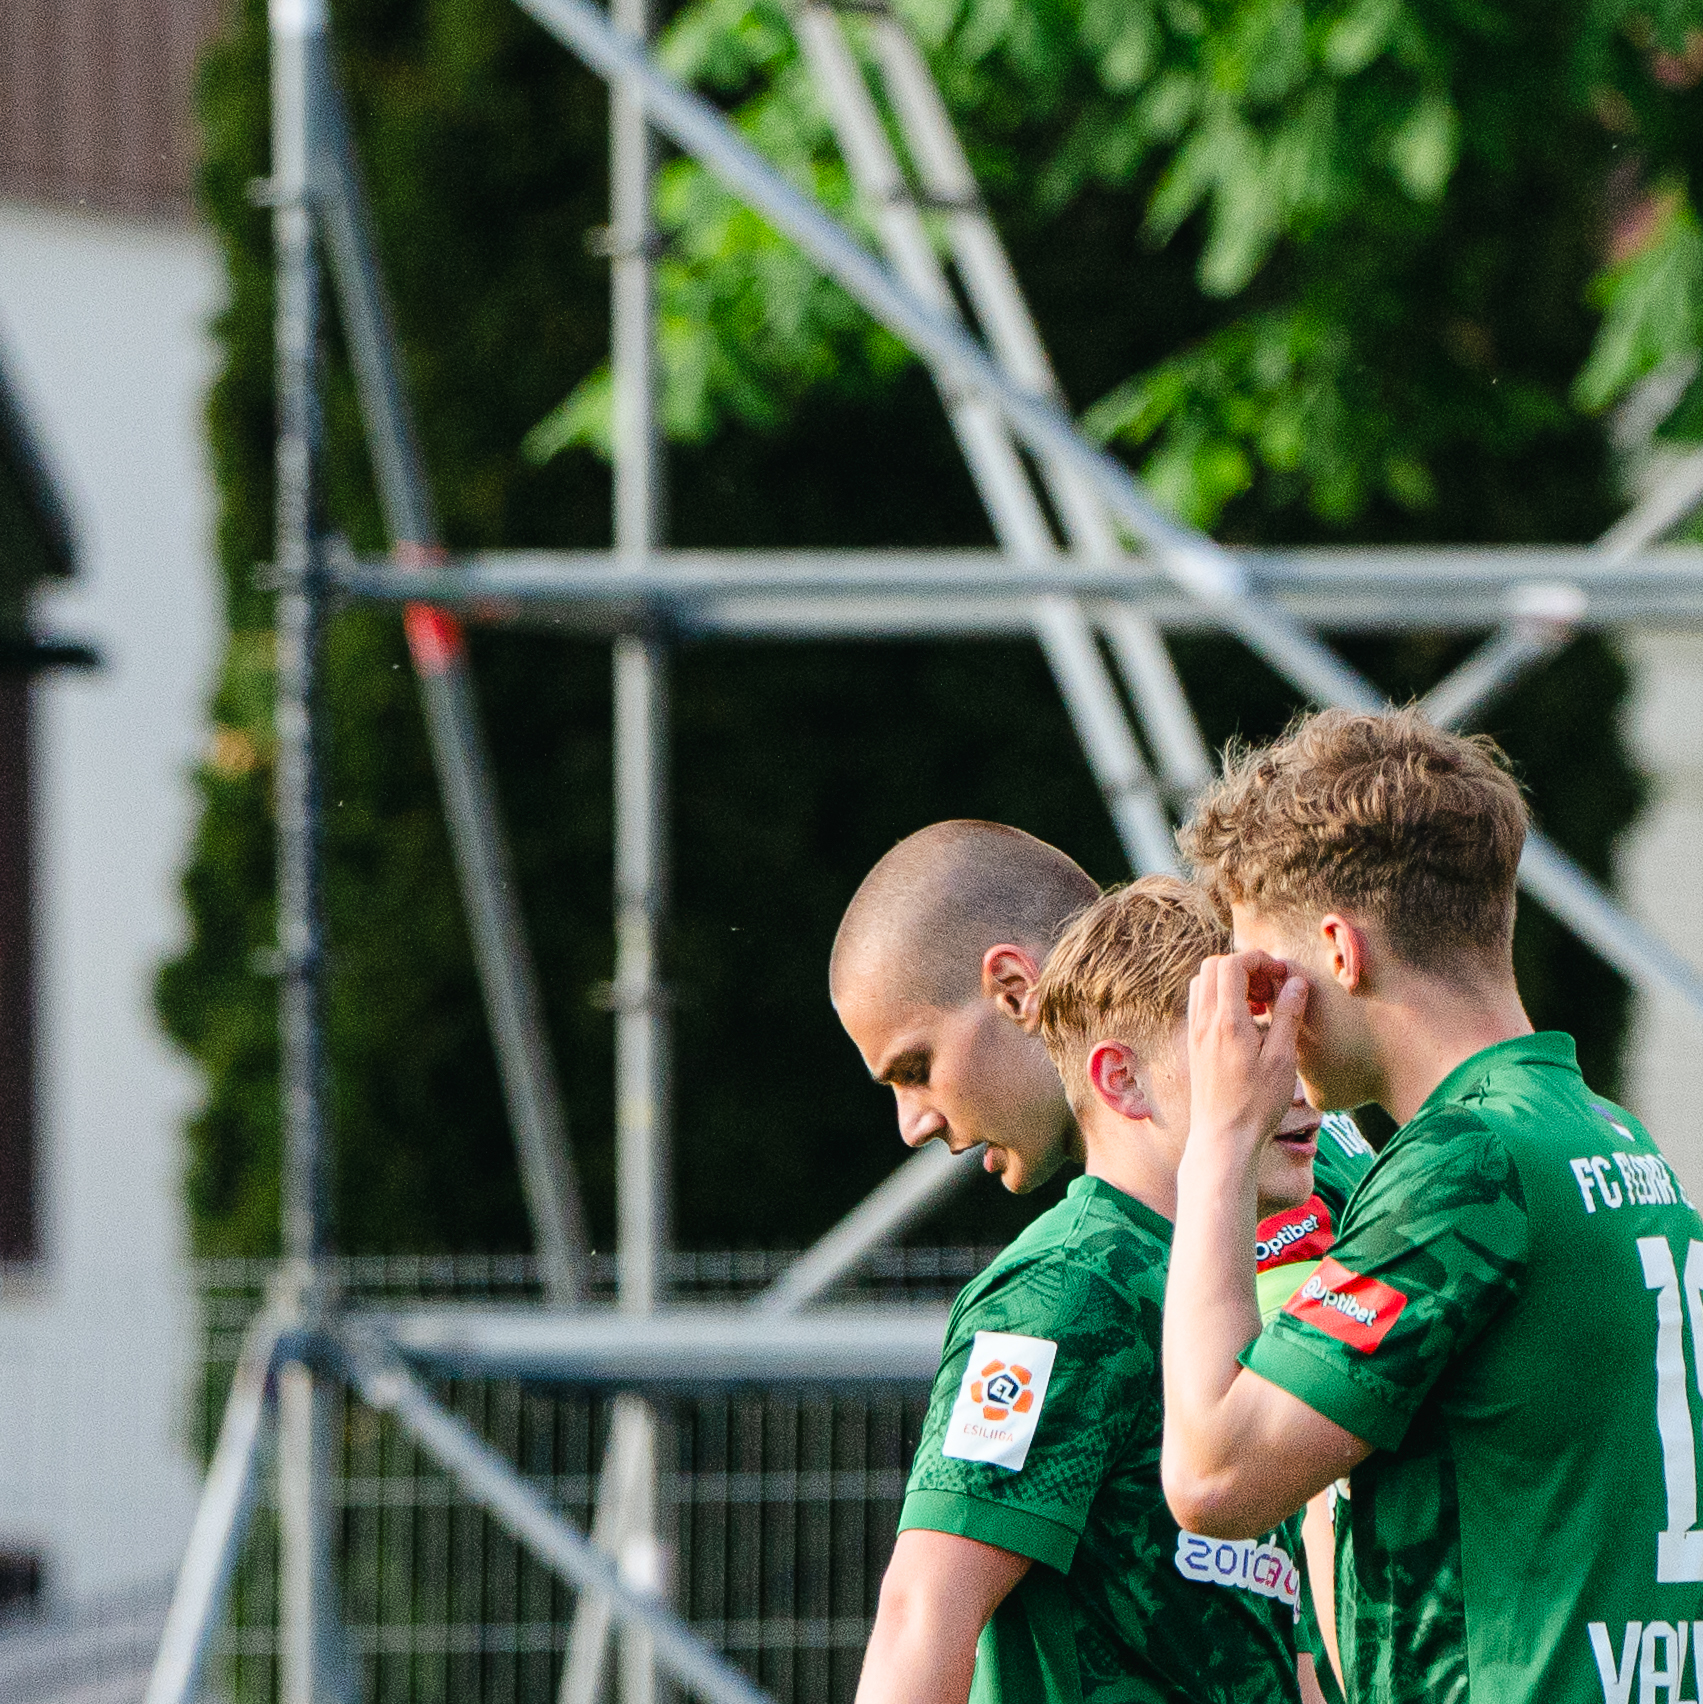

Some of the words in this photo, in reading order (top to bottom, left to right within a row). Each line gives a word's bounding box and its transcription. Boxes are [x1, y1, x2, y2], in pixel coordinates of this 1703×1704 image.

[1570, 1156, 1623, 1213] FC
[1256, 1214, 1319, 1261] Optibet
[963, 1423, 1013, 1442] ESILIIGA
